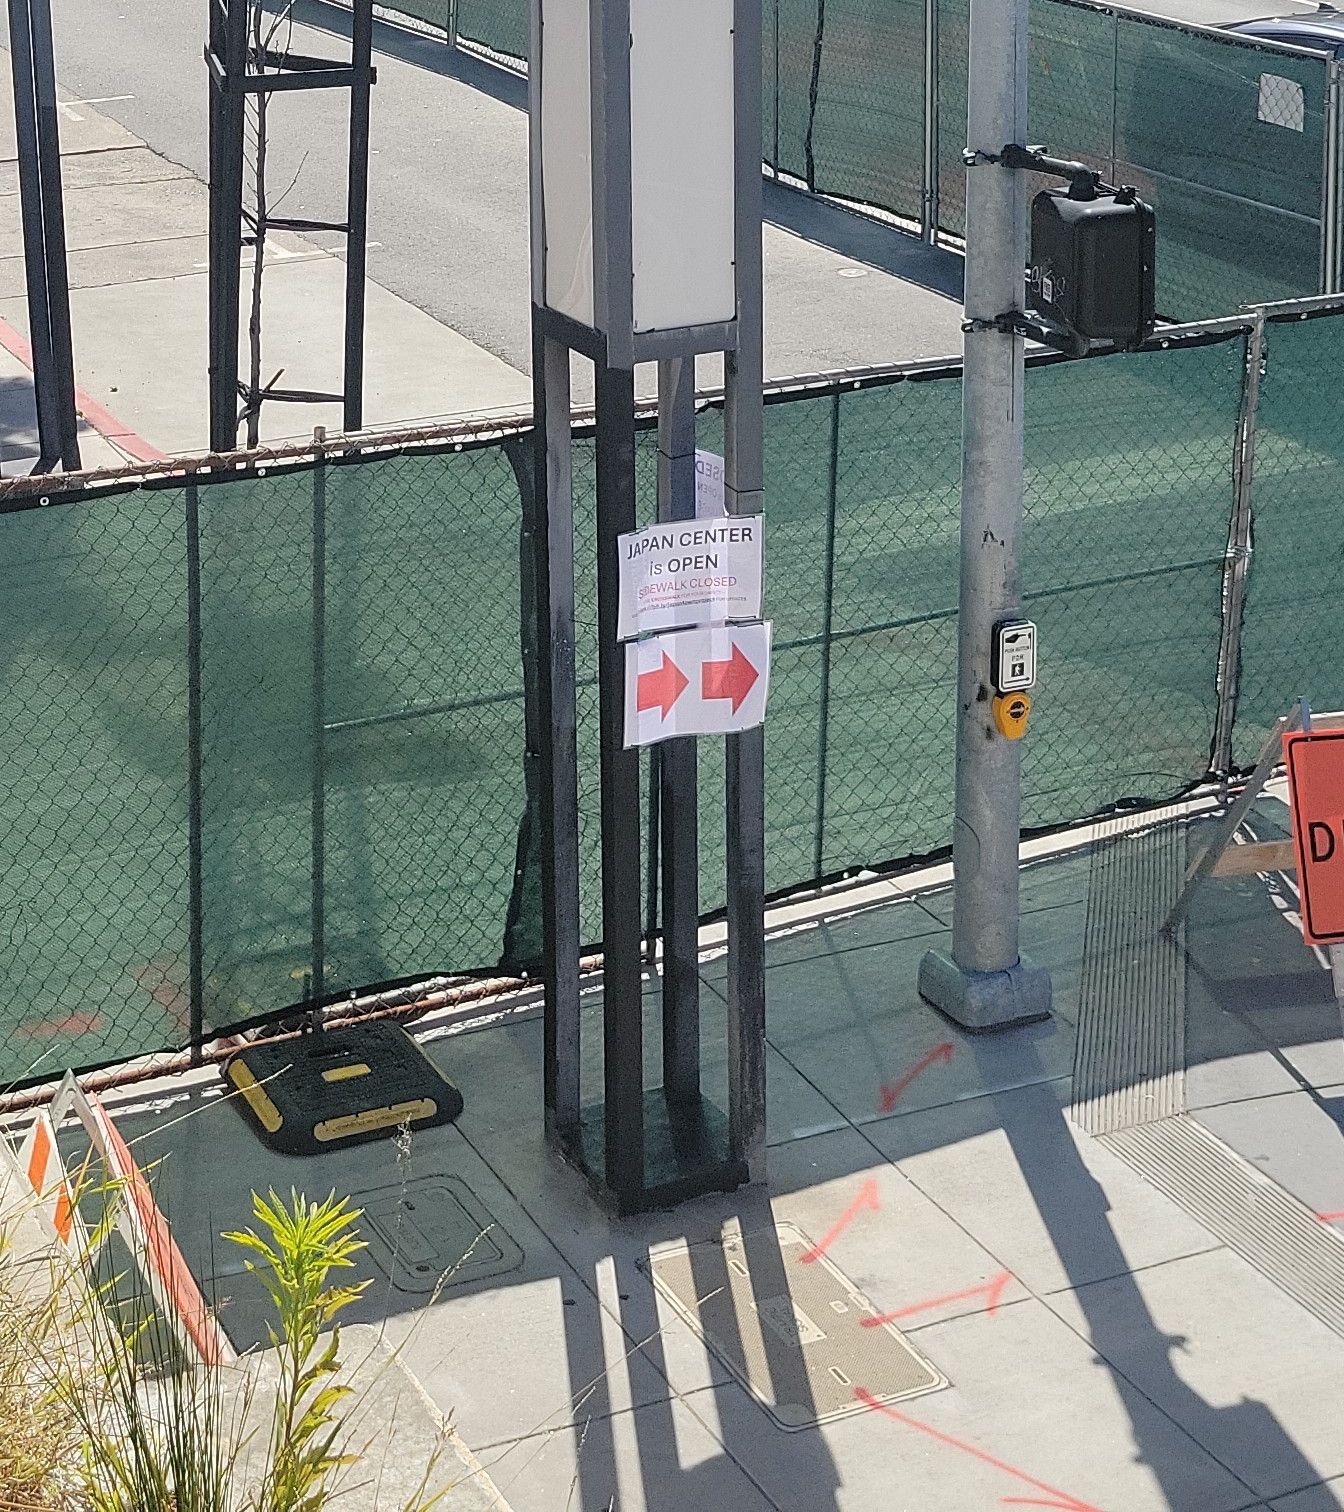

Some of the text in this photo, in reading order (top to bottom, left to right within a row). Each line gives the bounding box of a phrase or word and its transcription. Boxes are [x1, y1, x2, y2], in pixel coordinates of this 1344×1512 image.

[627, 527, 753, 560] JAPAN CENTER
[649, 554, 718, 576] is OPEN
[638, 576, 737, 600] SIDEWALK CLOSED
[1011, 654, 1024, 662] FOR
